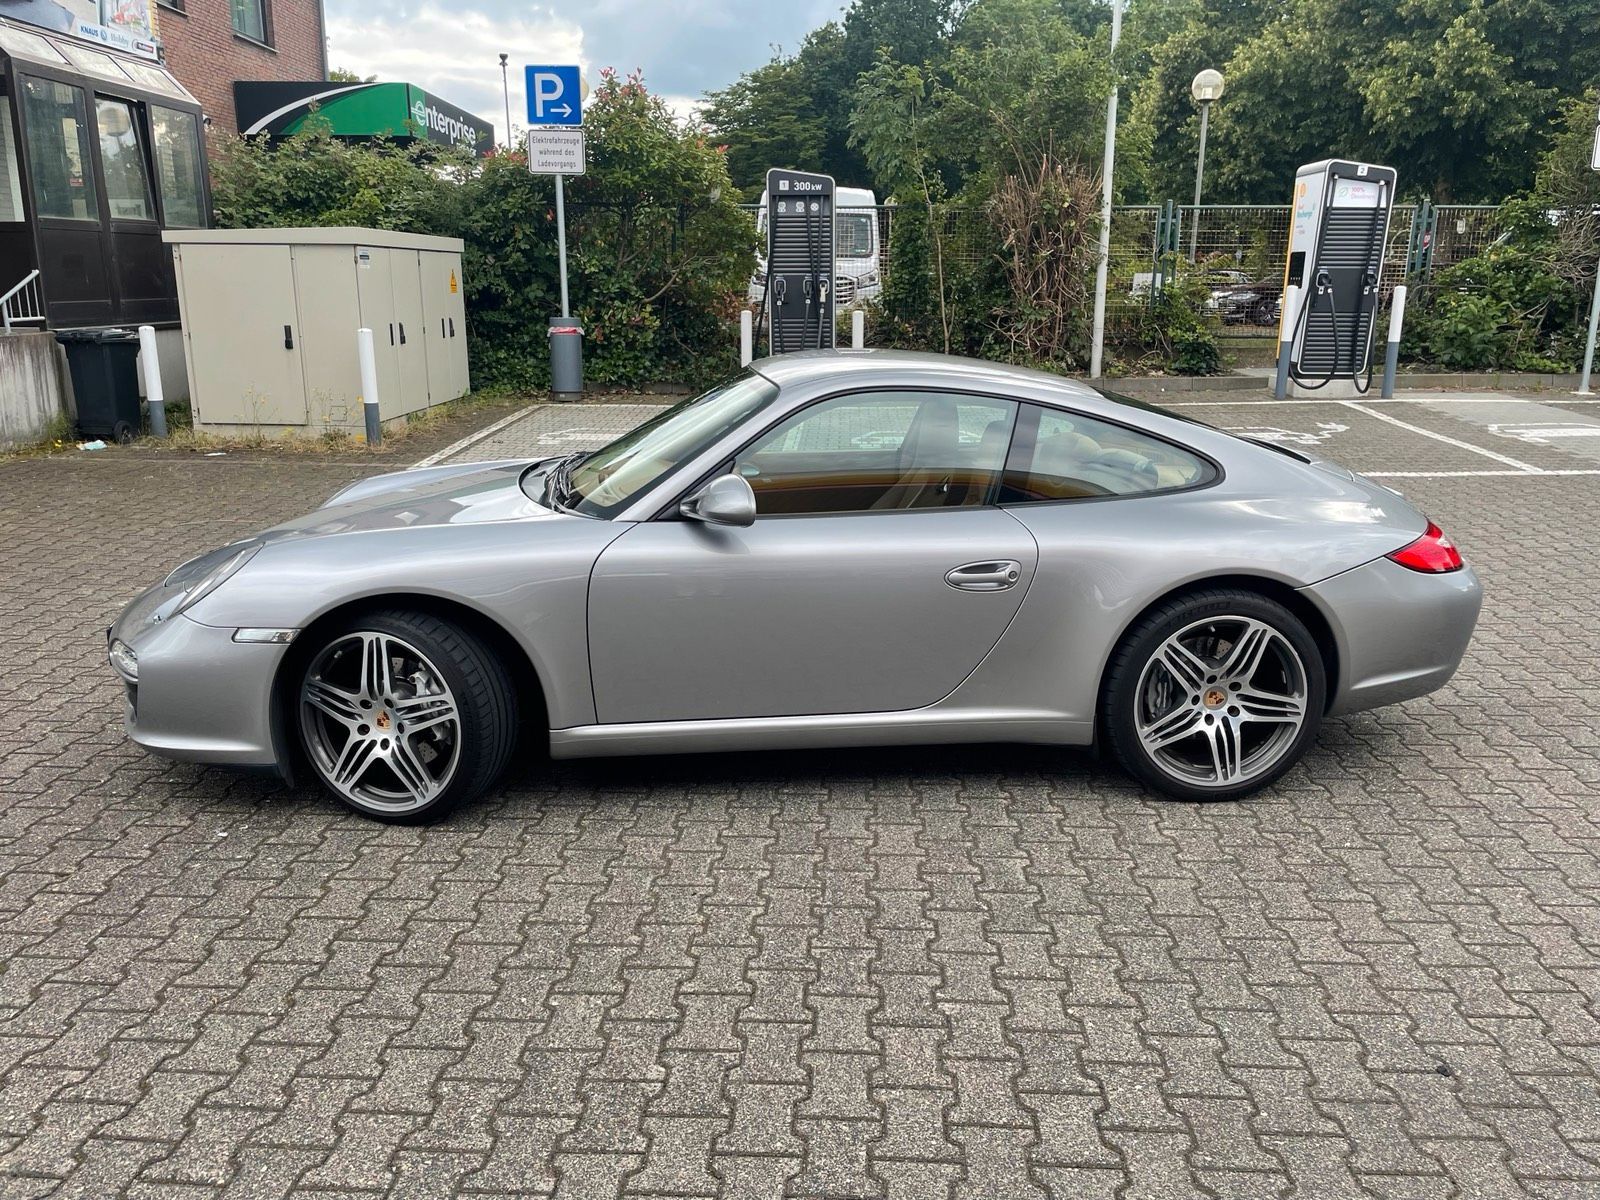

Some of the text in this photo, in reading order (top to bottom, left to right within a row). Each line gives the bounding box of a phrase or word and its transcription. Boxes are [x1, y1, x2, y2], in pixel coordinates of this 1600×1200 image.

[80, 25, 98, 37] KNAUS
[534, 73, 564, 118] P
[411, 100, 476, 146] enterprise
[532, 135, 580, 145] Elektrofahrzeuge
[539, 148, 575, 156] während des
[538, 159, 577, 169] Ladevorgangs
